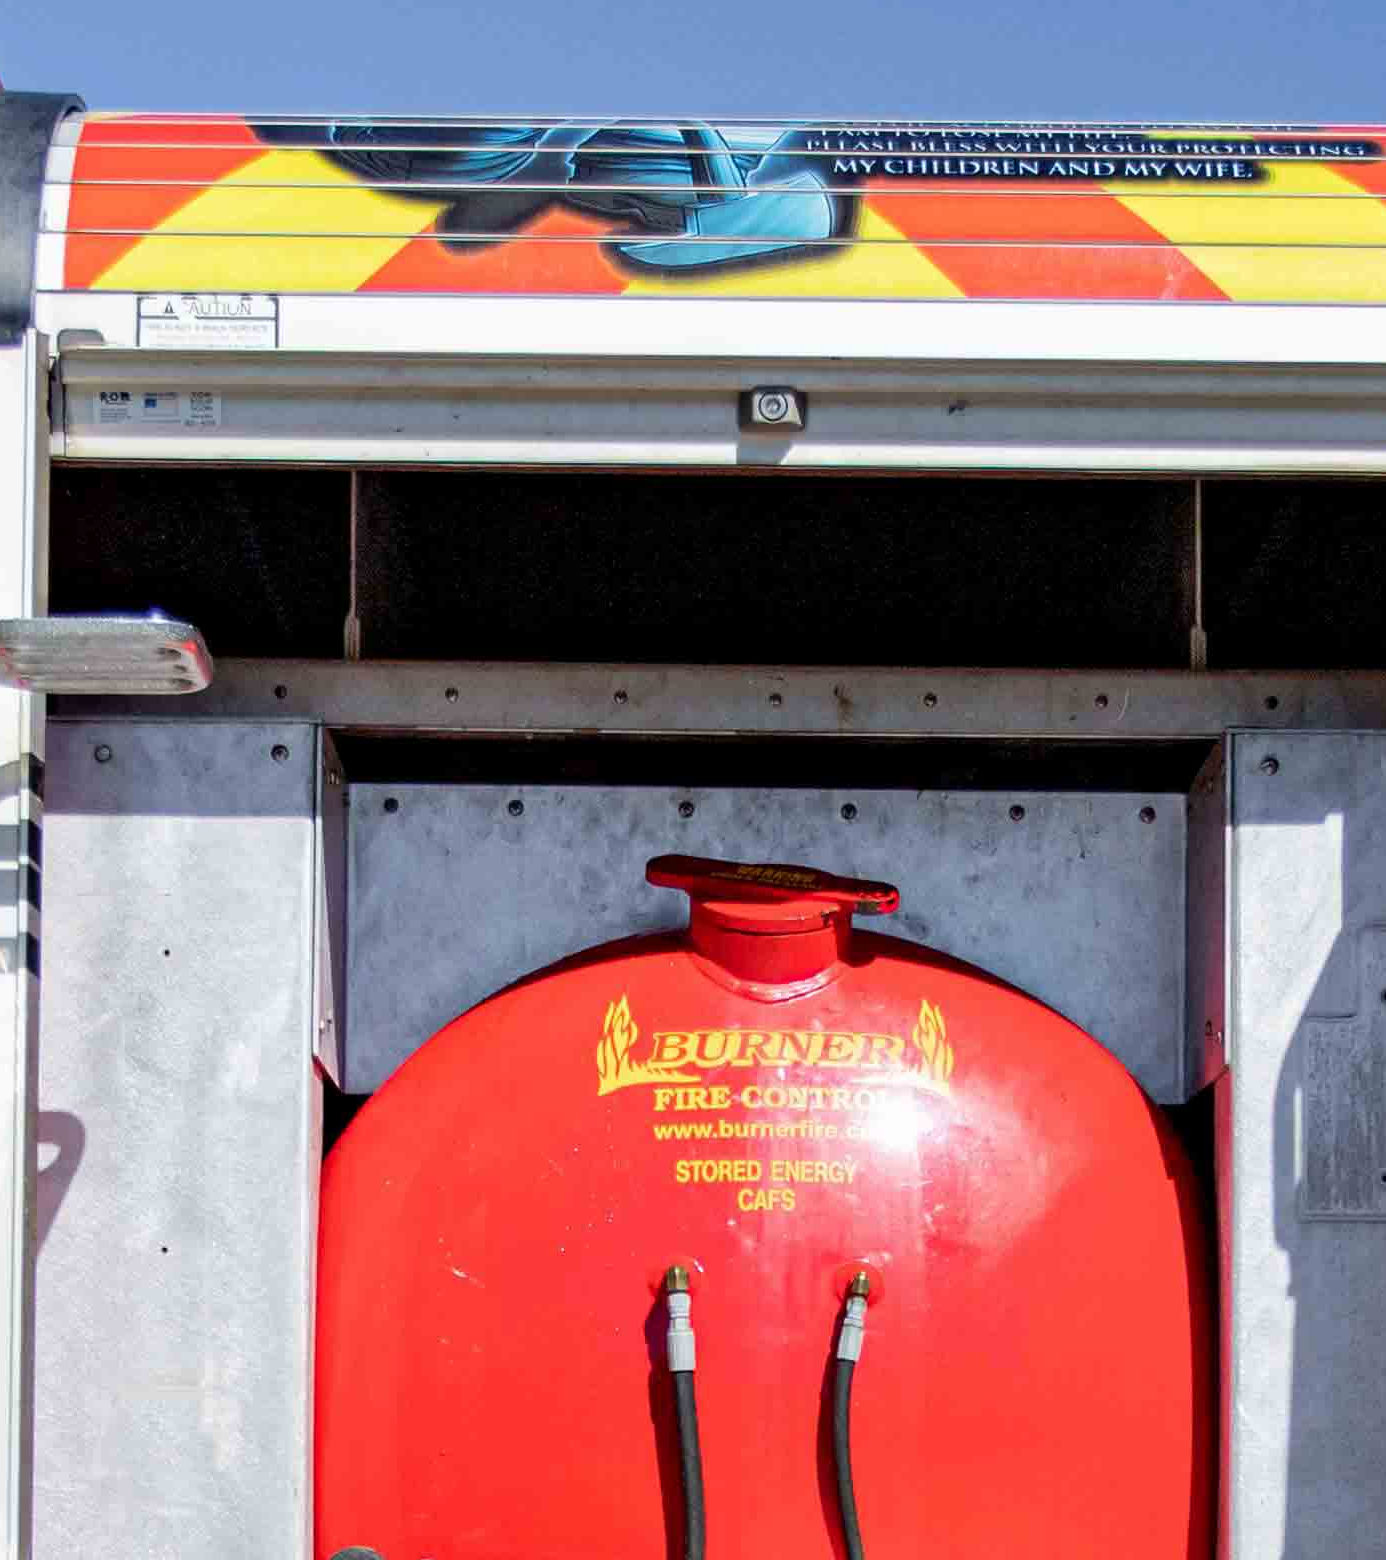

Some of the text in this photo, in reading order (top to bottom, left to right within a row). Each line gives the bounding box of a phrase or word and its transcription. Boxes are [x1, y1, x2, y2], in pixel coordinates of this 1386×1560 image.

[806, 140, 1364, 156] PLEASE BLESS WITH YOUR PROTECTING
[833, 159, 1253, 178] MY CHILDREN AND MY WIFE.
[184, 301, 252, 316] AUTION
[650, 1028, 905, 1069] BURNER
[653, 1088, 731, 1111] FIRE
[675, 1159, 858, 1184] STORED ENERGY
[737, 1189, 796, 1213] CAFS
